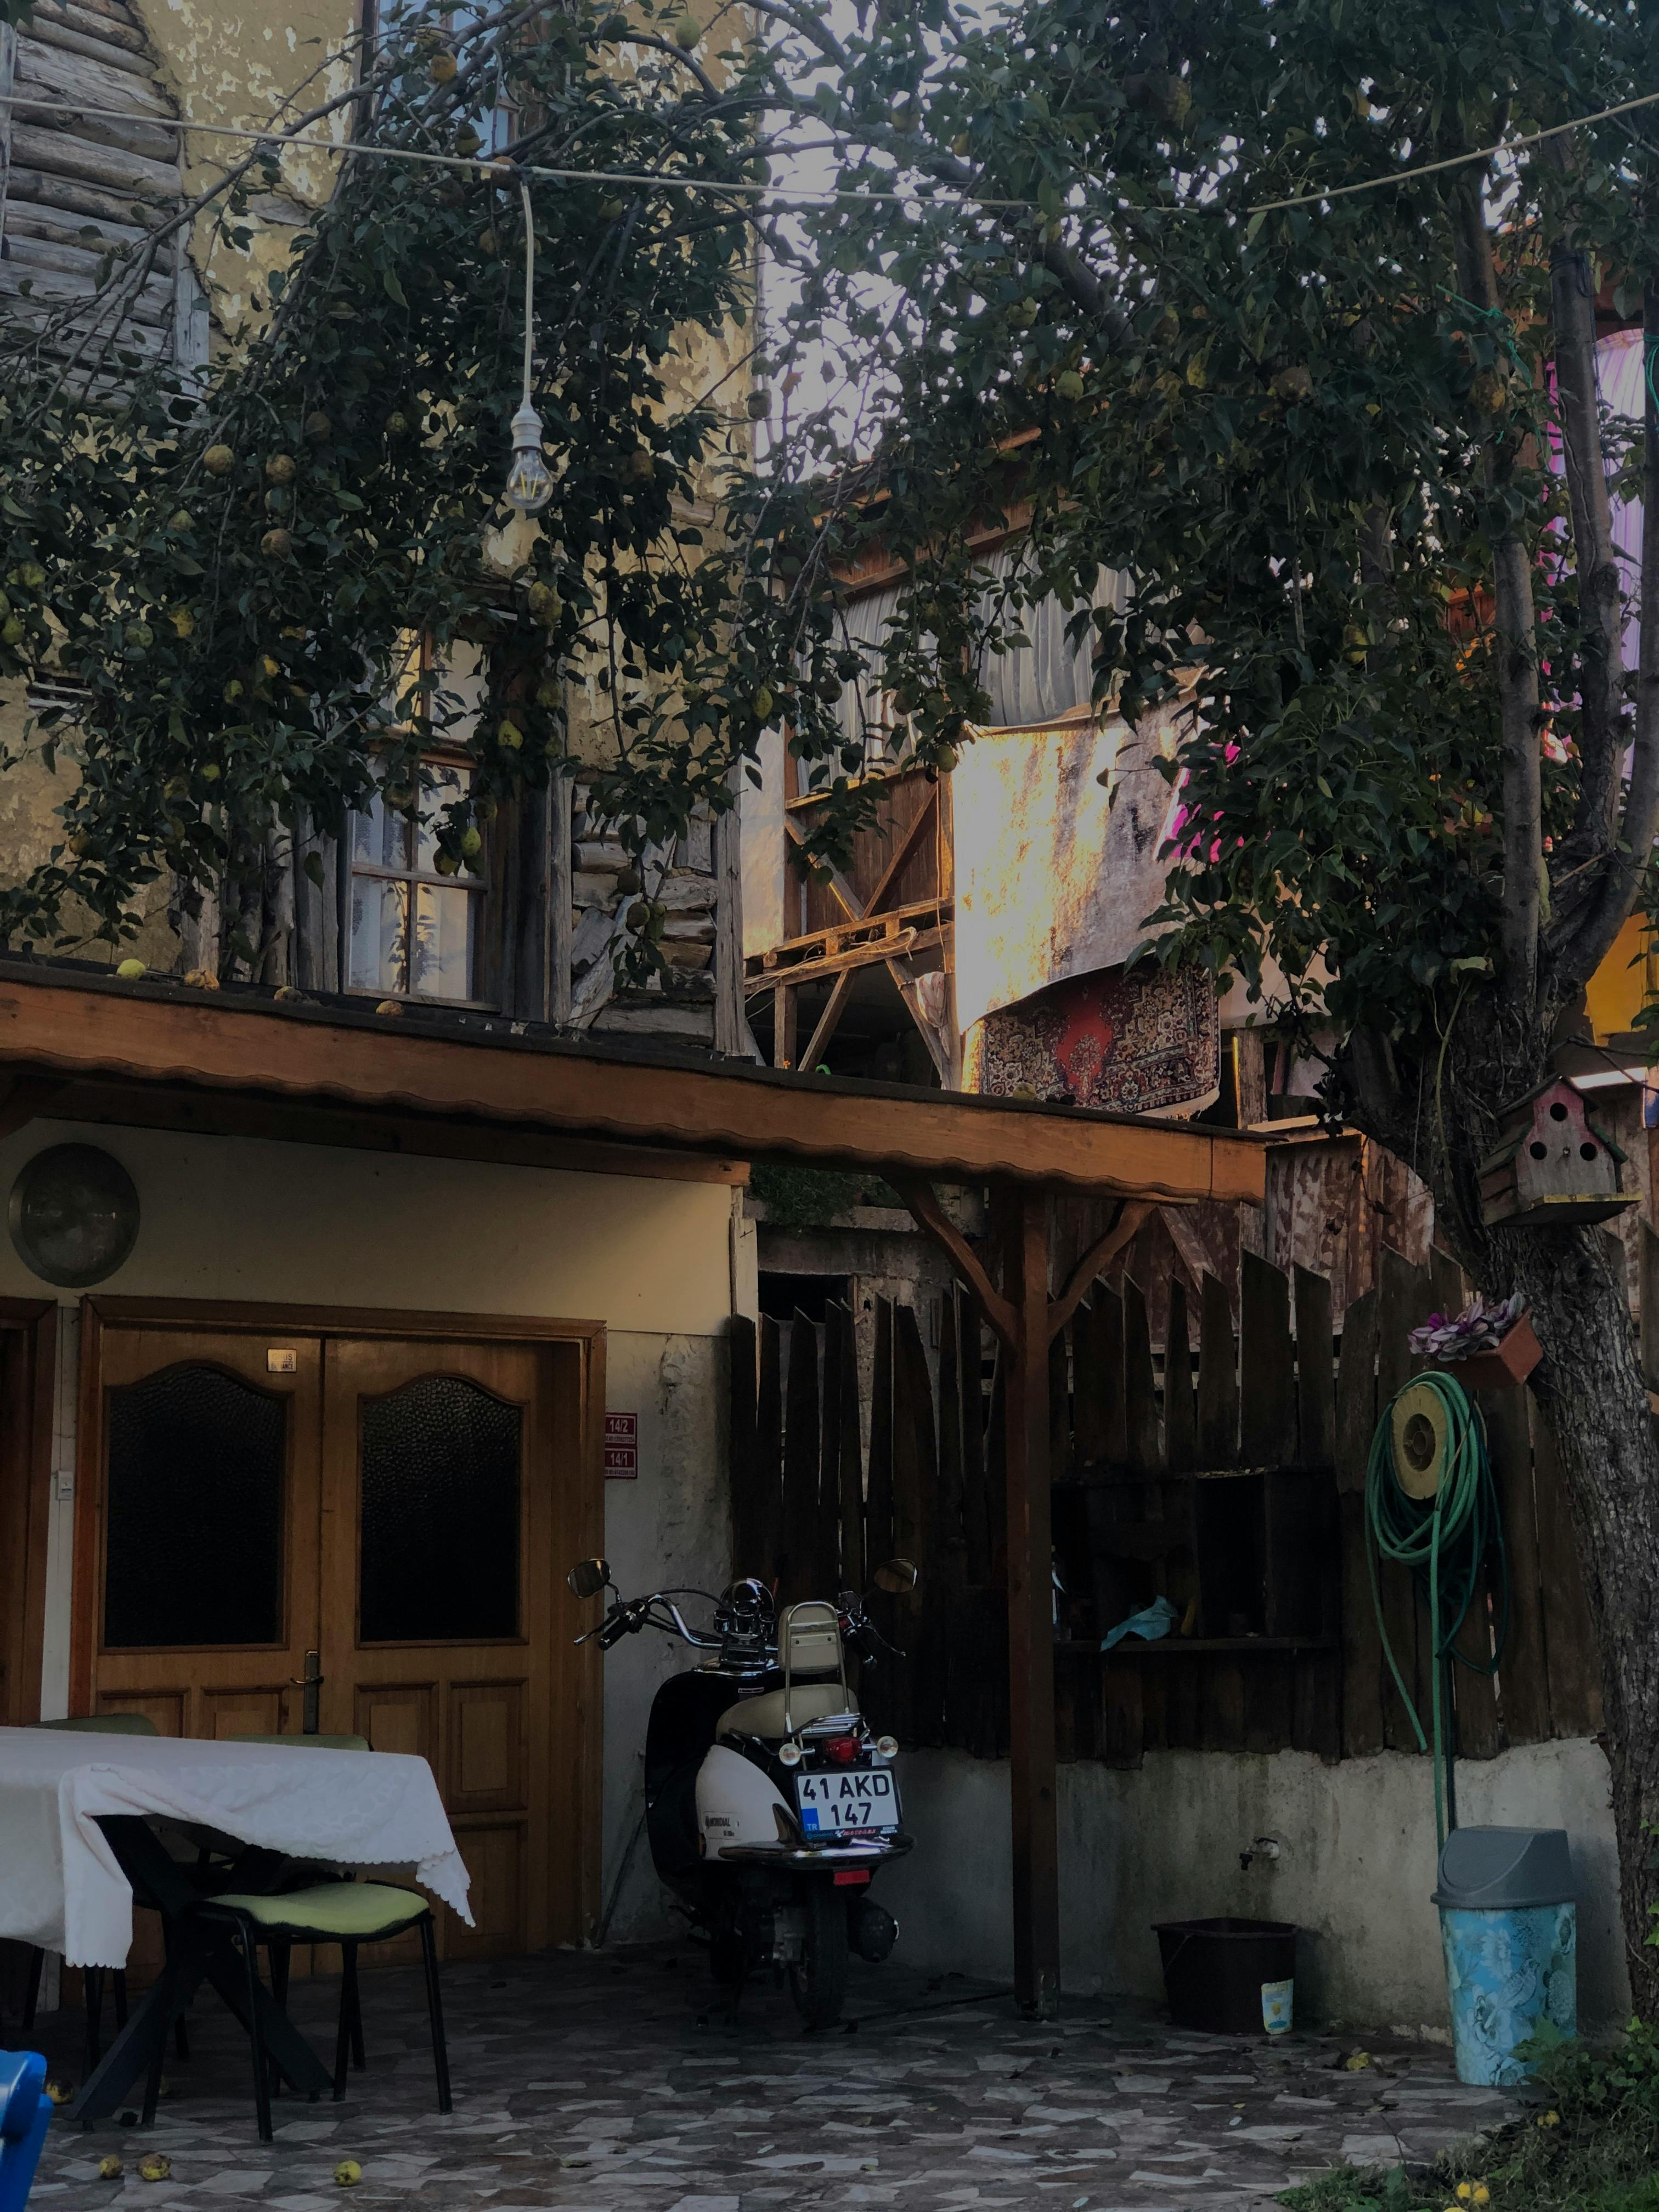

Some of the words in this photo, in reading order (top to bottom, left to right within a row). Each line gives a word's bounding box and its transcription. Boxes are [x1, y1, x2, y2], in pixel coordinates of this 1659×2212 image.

[610, 1419, 628, 1432] 14/2
[610, 1452, 628, 1466] 14/1
[803, 1778, 829, 1800] 41
[839, 1775, 890, 1798] AKD
[831, 1802, 872, 1826] 147
